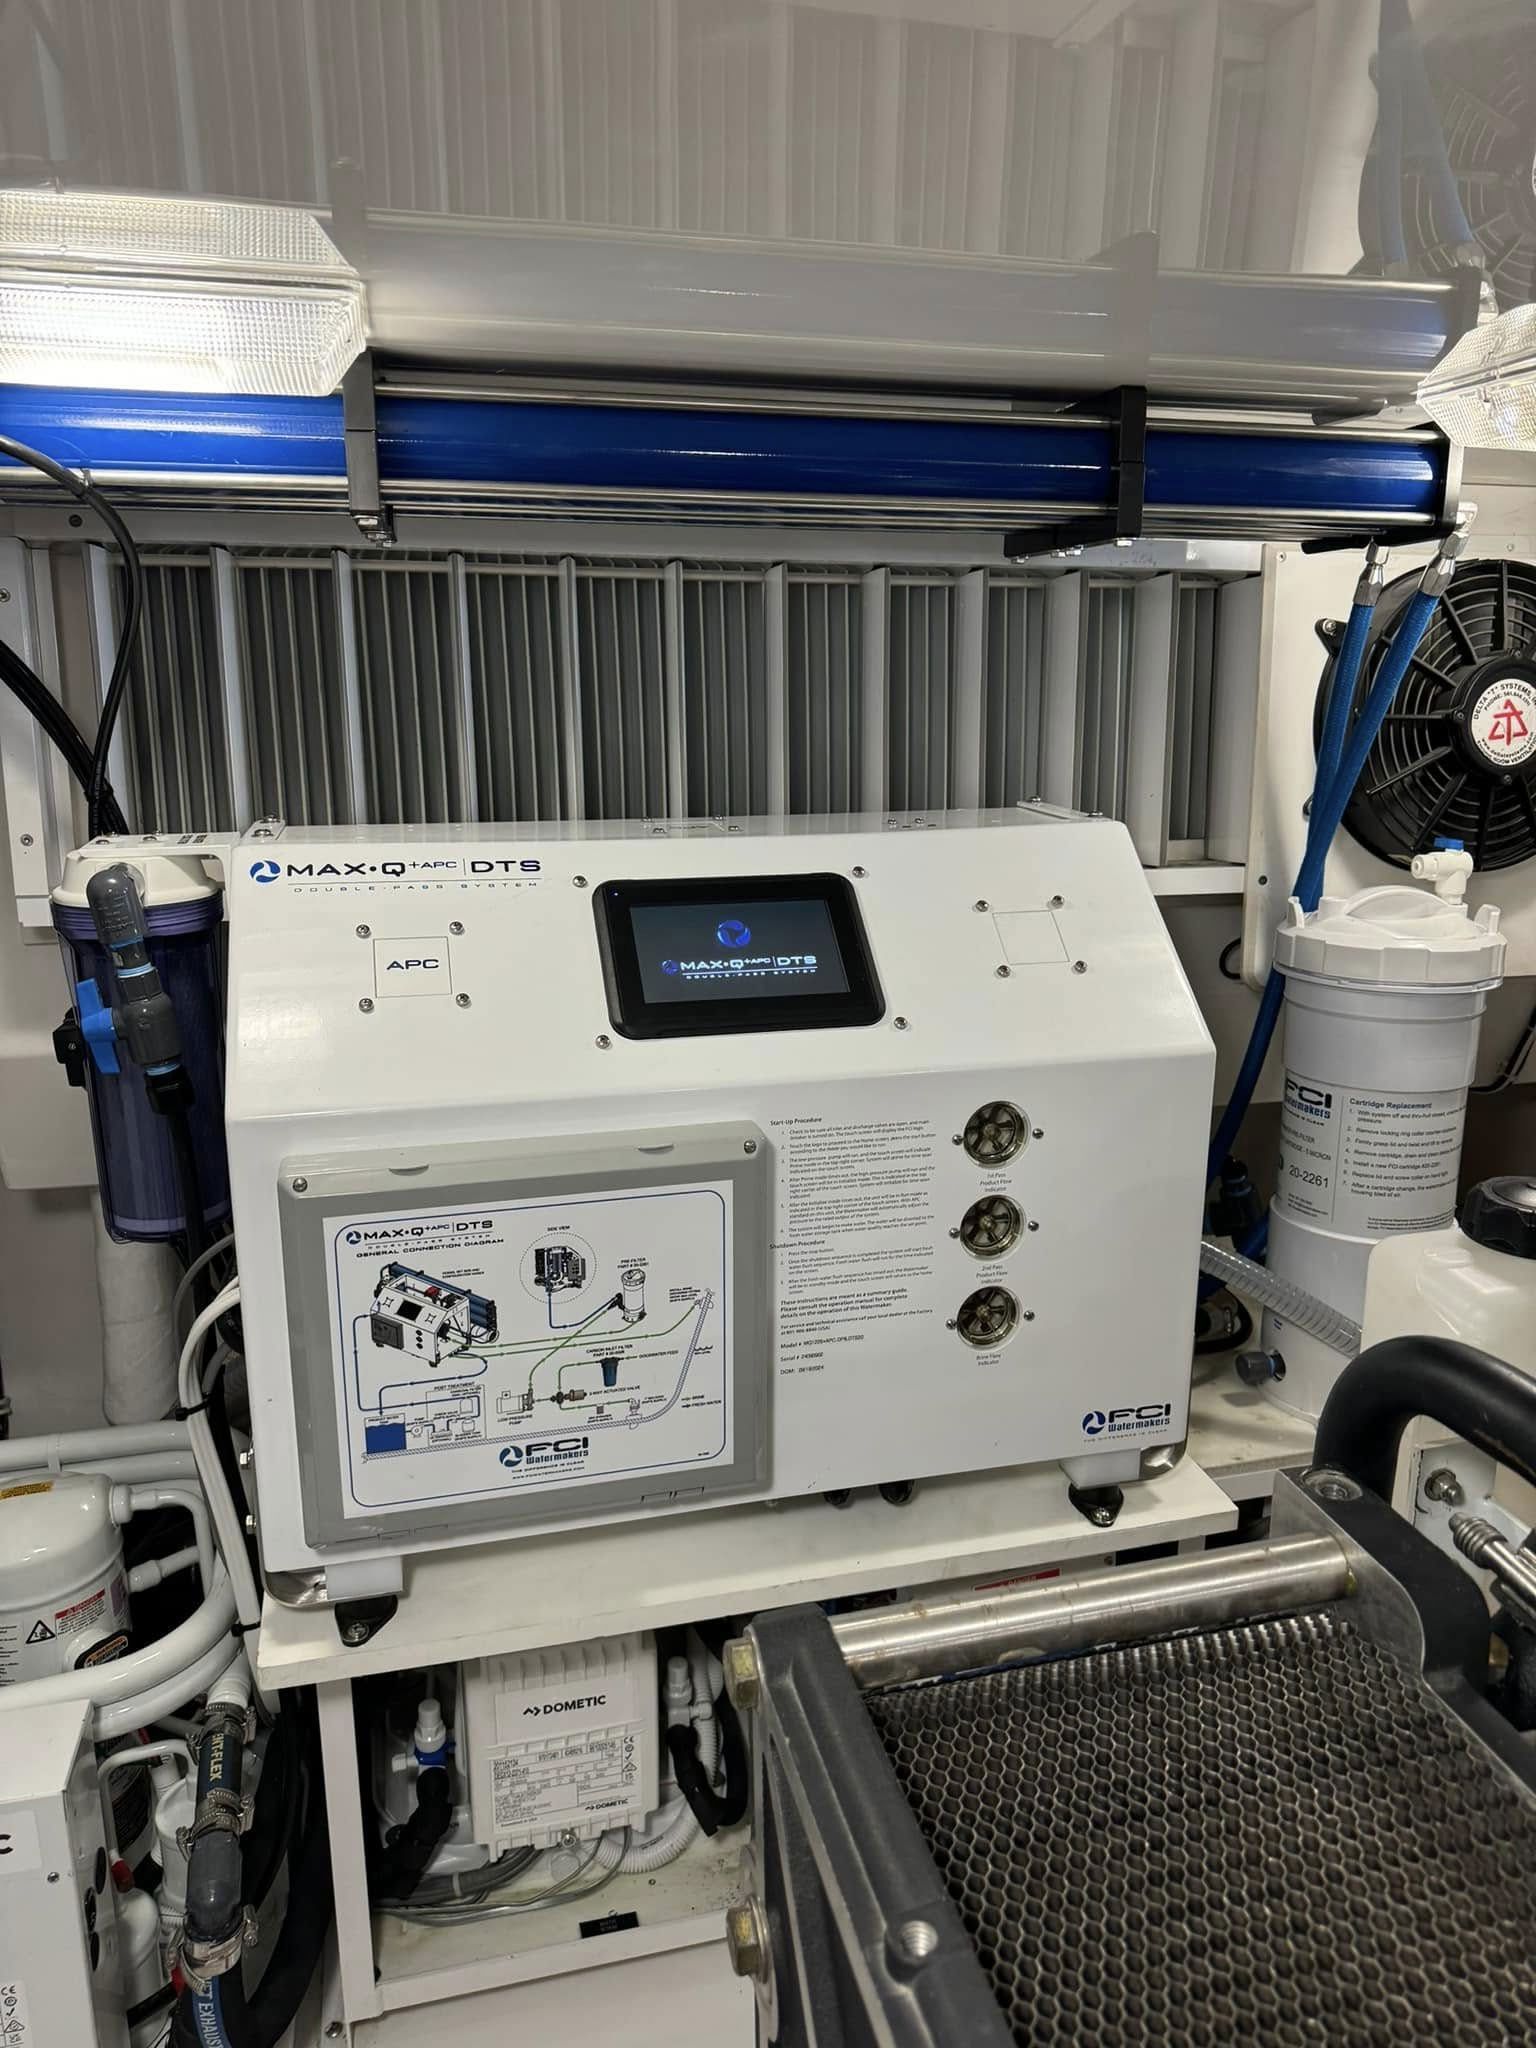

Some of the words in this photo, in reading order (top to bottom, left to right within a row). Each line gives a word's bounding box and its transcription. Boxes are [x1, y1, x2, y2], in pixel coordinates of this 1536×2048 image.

[1474, 696, 1488, 720] DELTA
[470, 860, 542, 873] DTS
[387, 959, 440, 970] APC
[777, 955, 817, 966] DTS
[1349, 1098, 1385, 1109] Cartridge
[1386, 1101, 1432, 1110] Replacement
[1289, 1164, 1329, 1188] 20-2261
[456, 1220, 493, 1231] DTS
[356, 1249, 399, 1258] GENERAL
[403, 1242, 461, 1253] CONNECTION
[464, 1238, 504, 1247] DIAGRAM
[1108, 1403, 1171, 1423] FCI
[1108, 1417, 1170, 1433] Watermakers
[526, 1437, 588, 1456] FCI
[526, 1450, 589, 1465] Watermakers
[543, 1695, 606, 1715] DOMETIC
[595, 1798, 628, 1810] DOMETIC
